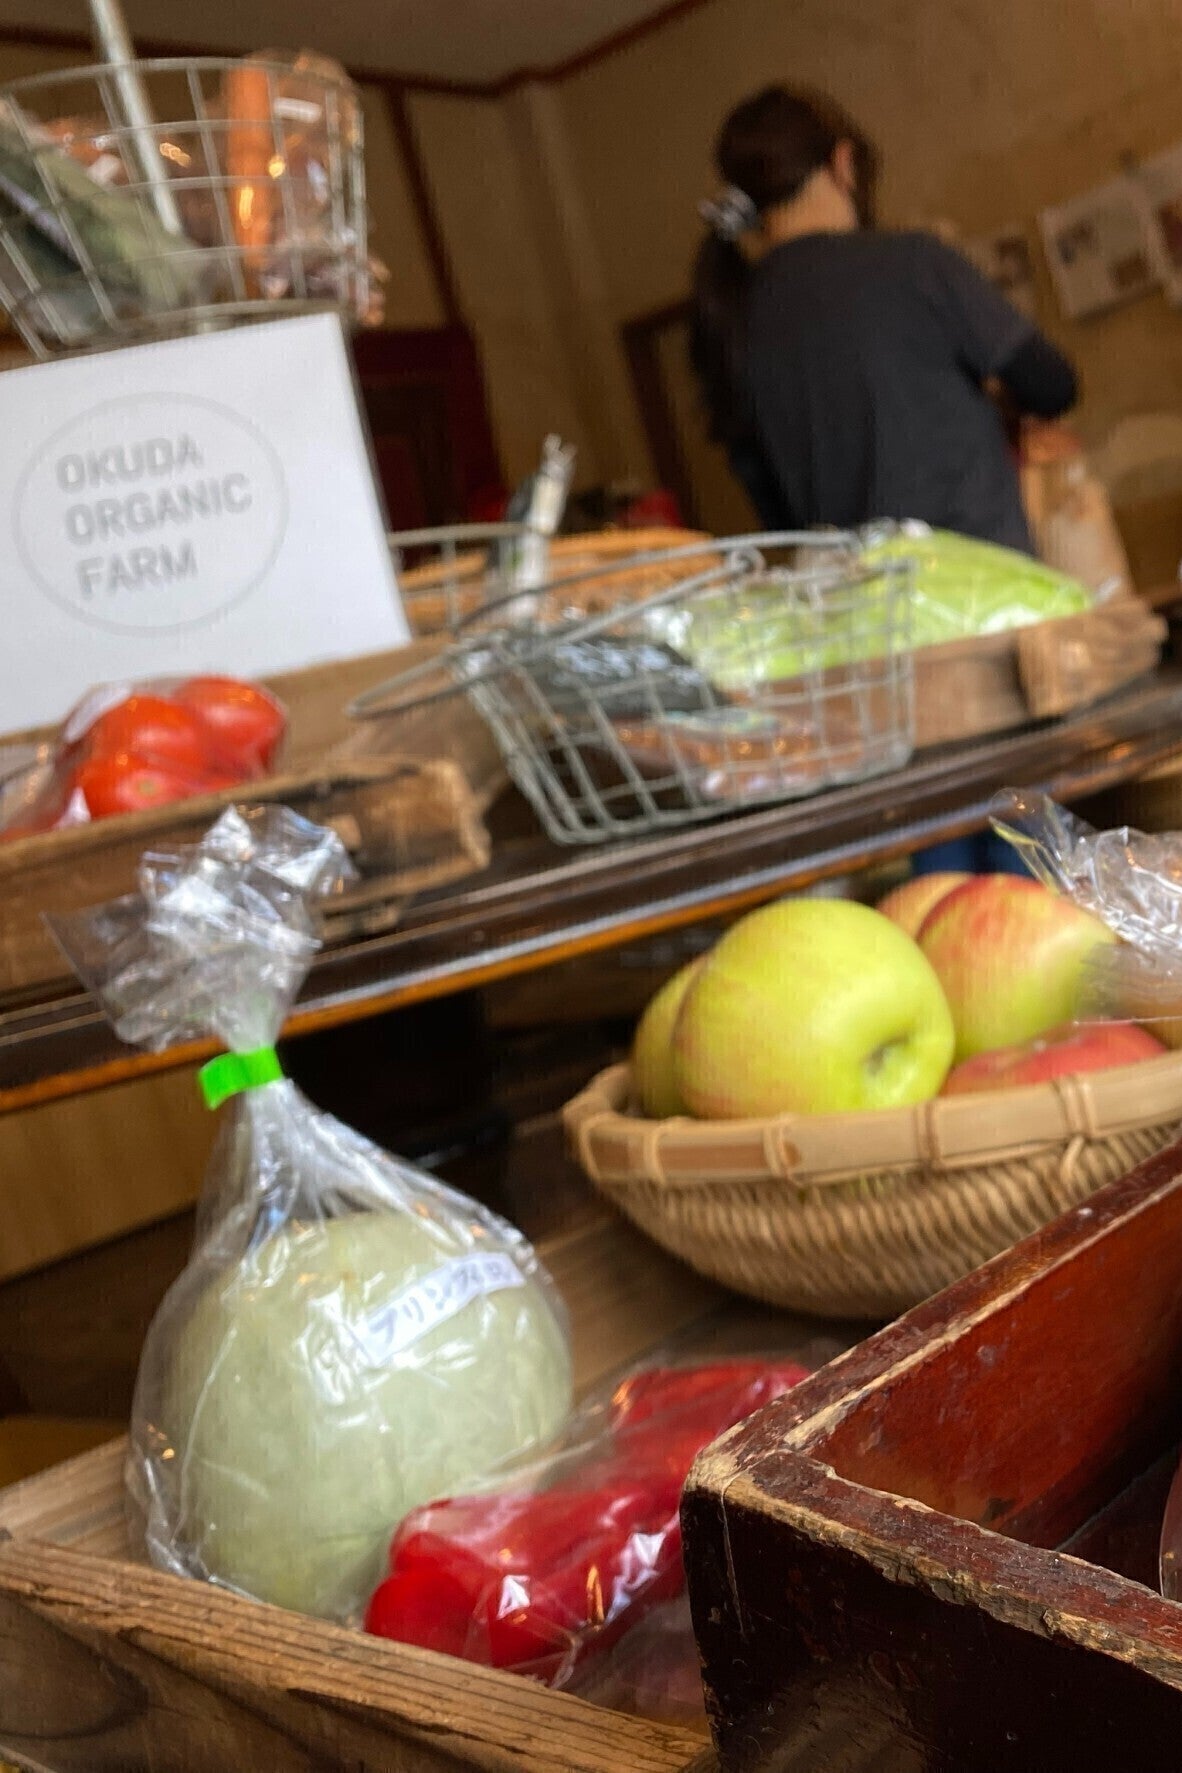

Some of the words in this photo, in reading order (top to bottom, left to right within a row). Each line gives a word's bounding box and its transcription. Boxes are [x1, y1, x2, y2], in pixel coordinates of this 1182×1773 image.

[58, 436, 202, 491] OKUDA
[67, 474, 252, 544] ORGANIC
[78, 542, 197, 597] FARM
